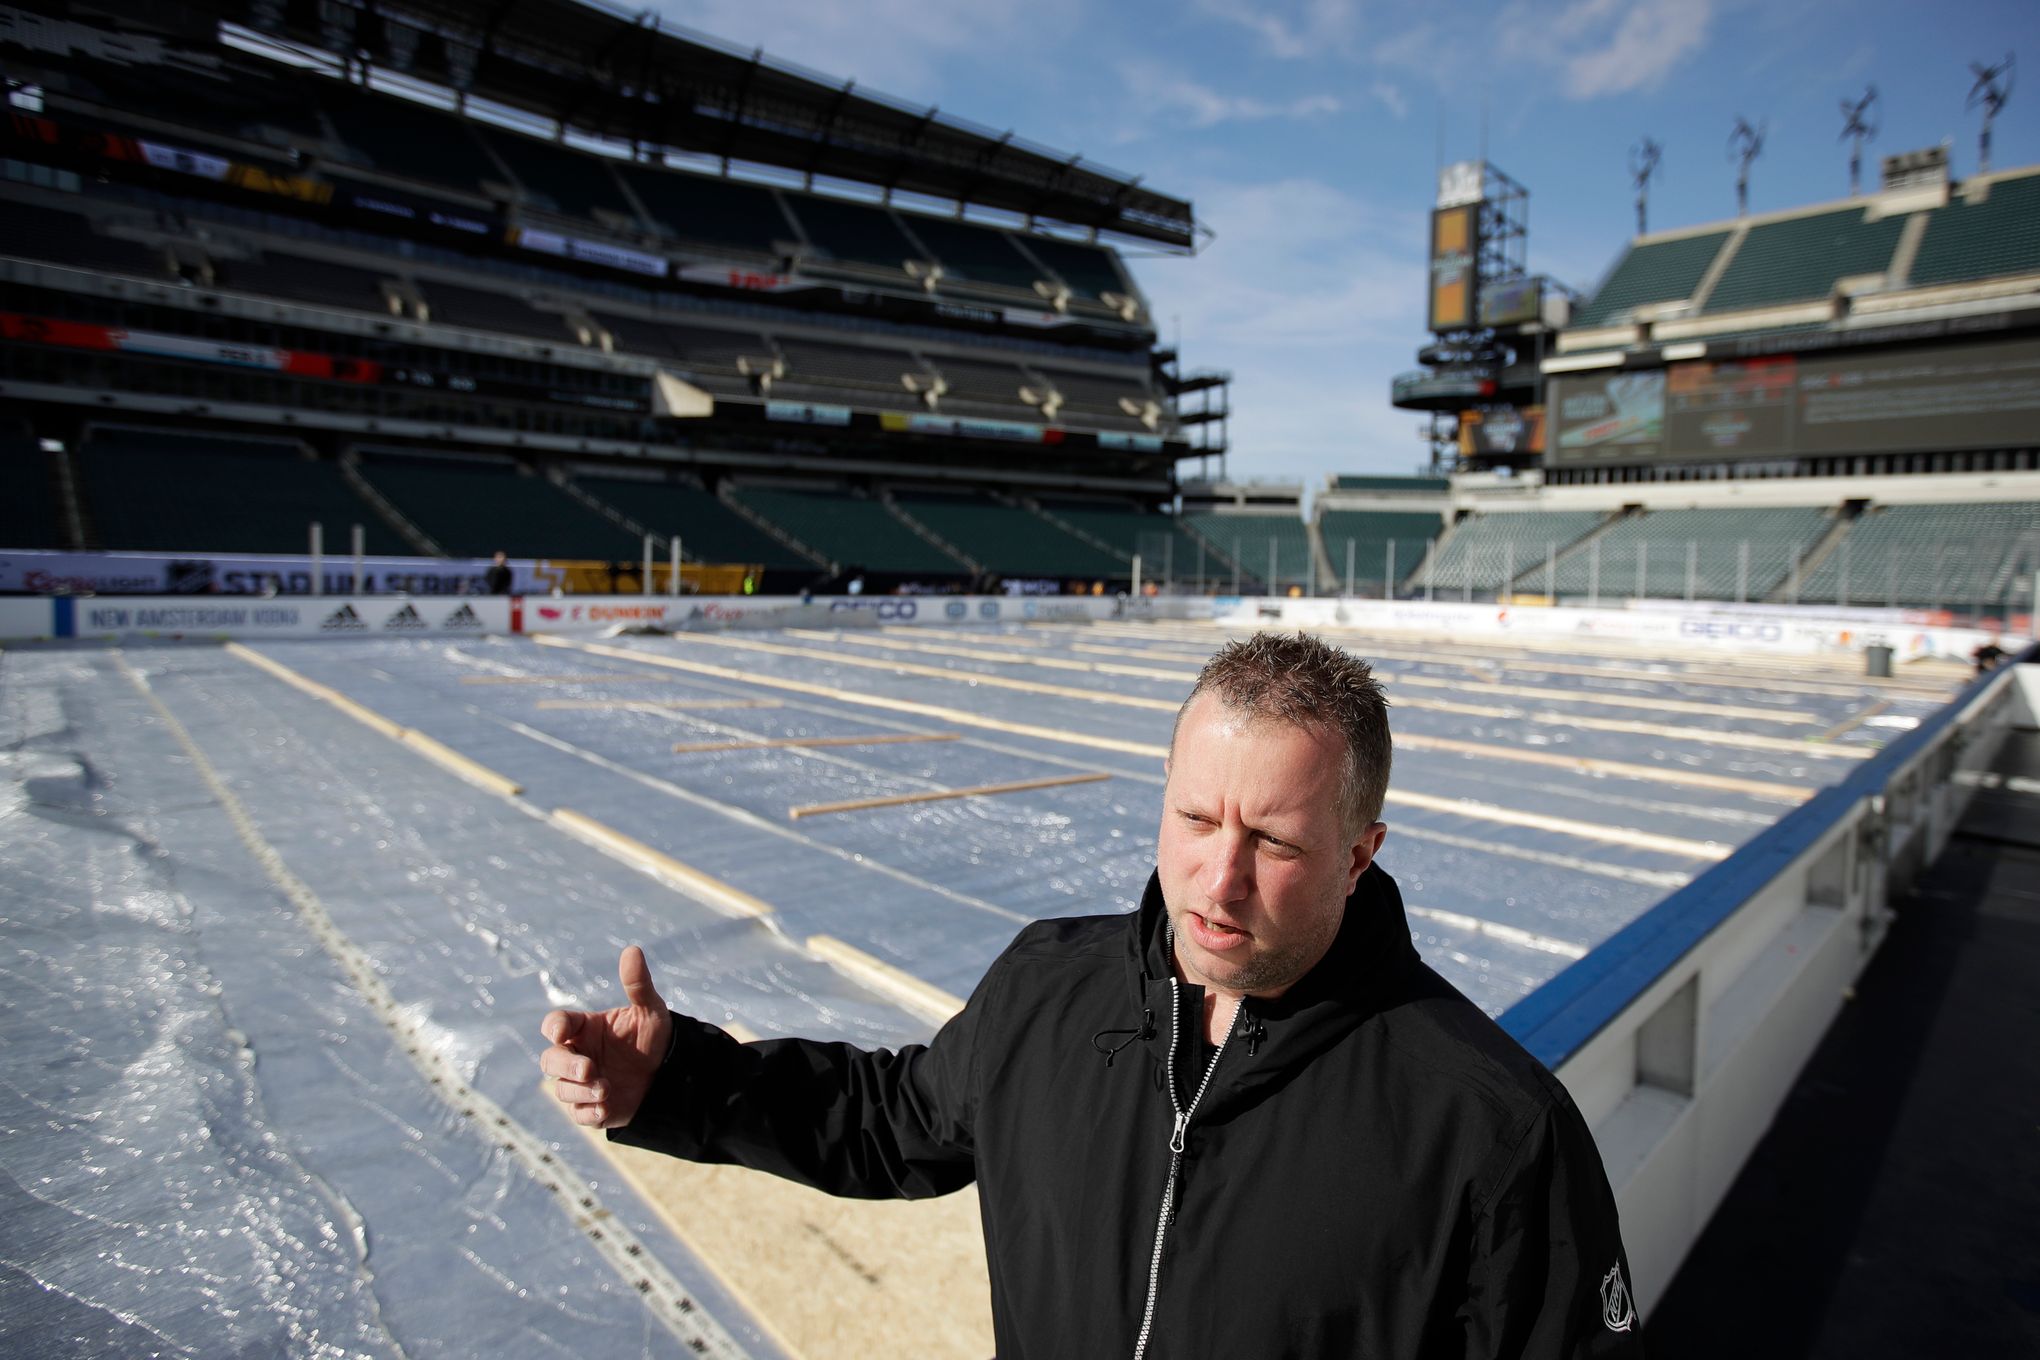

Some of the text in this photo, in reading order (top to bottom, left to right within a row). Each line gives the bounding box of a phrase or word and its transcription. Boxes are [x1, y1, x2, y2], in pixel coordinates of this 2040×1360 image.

[224, 571, 375, 595] STADUM
[91, 607, 300, 627] NEW AMSTERDAM VODKA
[1681, 621, 1782, 641] GEICO
